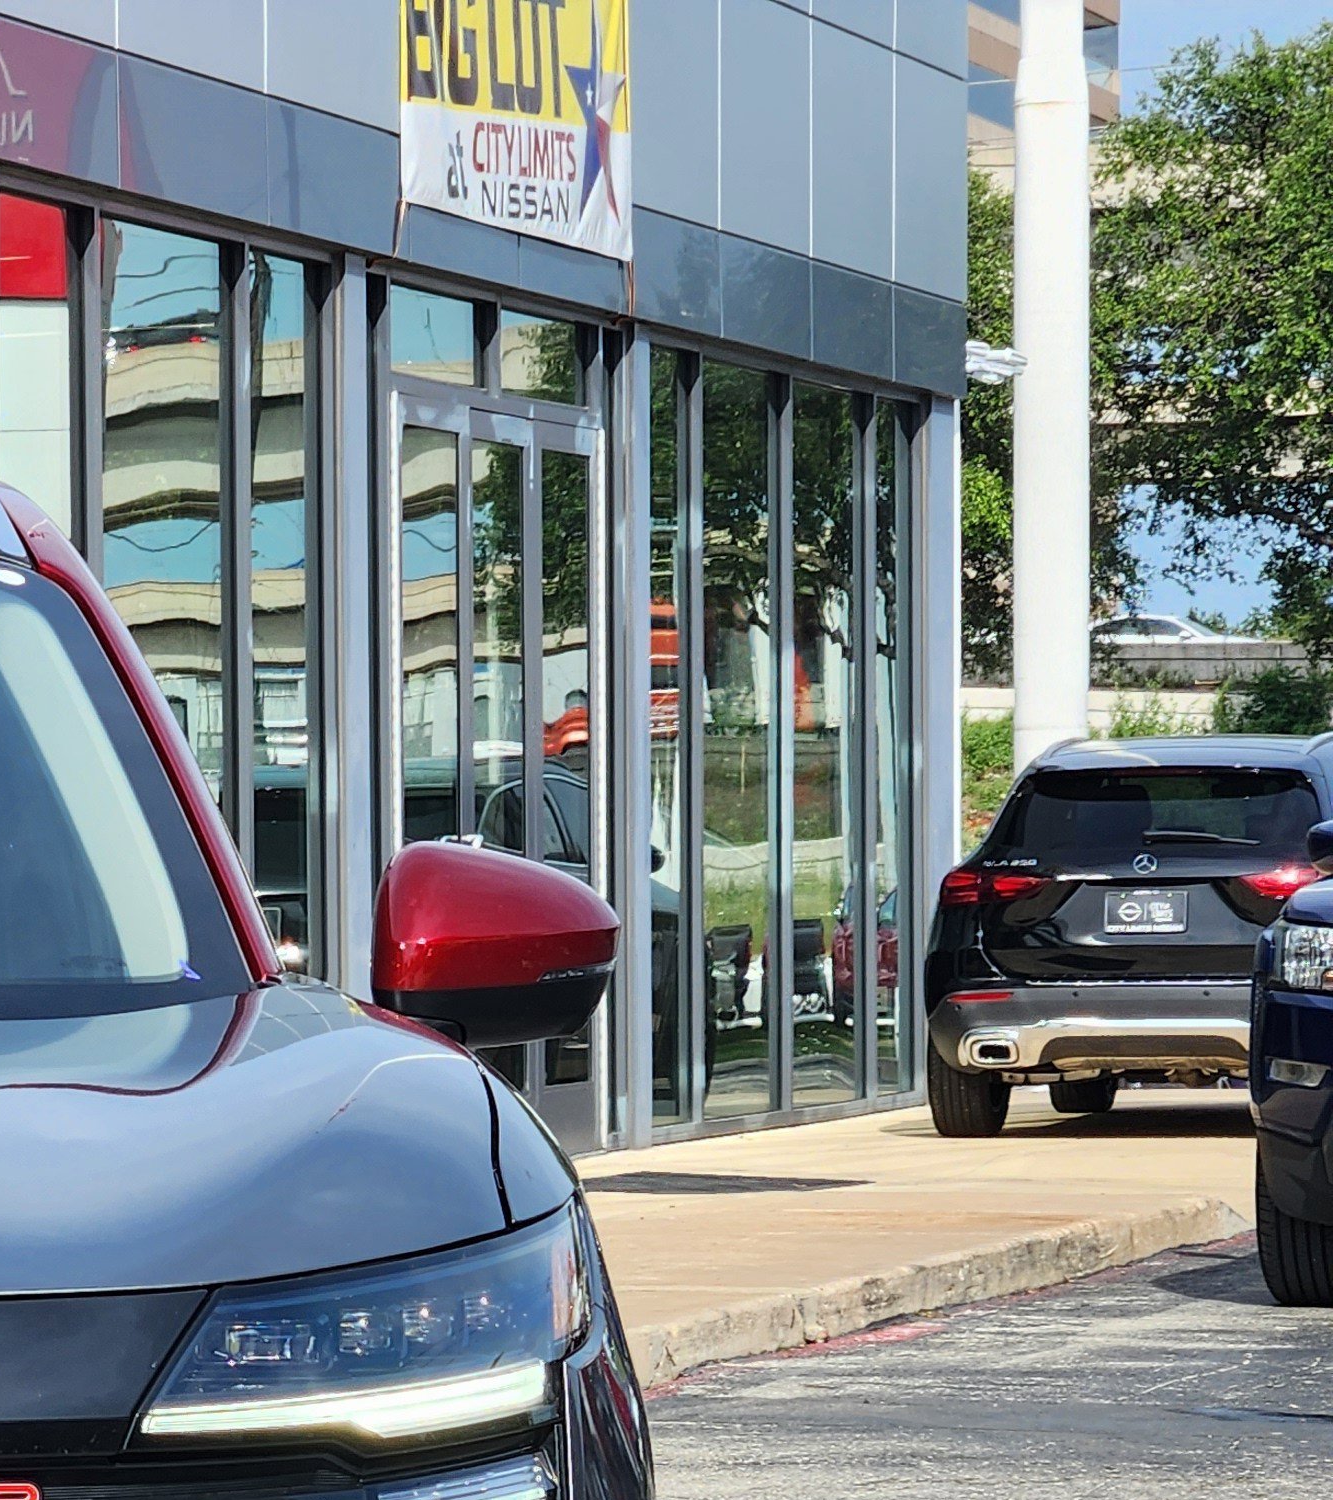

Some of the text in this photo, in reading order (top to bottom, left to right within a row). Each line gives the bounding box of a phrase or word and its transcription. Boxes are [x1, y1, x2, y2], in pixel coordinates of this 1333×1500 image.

[487, 0, 565, 118] LOT
[447, 130, 468, 200] at
[472, 121, 576, 182] CITY LIMITS
[481, 180, 570, 223] NISSAN
